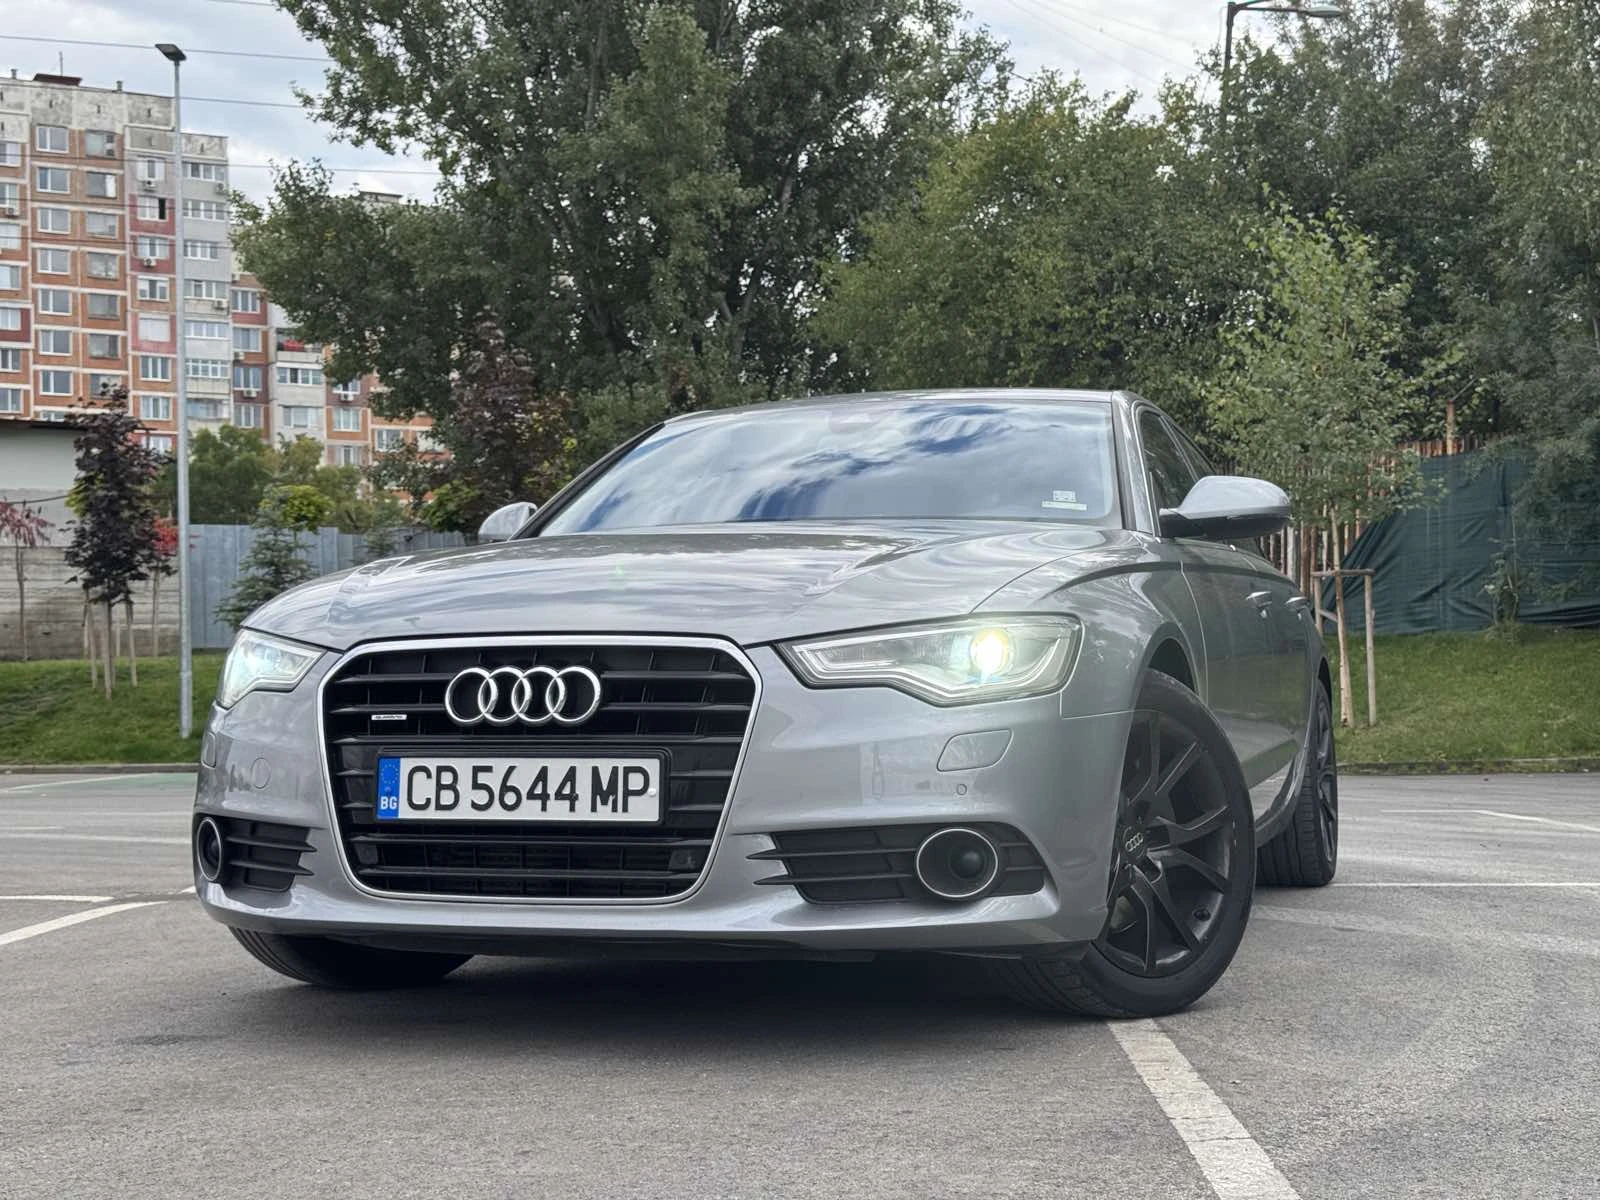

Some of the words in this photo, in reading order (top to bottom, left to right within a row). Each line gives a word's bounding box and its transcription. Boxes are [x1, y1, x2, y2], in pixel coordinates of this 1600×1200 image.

[380, 796, 398, 810] BG
[406, 765, 460, 811] CB
[470, 765, 579, 812] 5644
[590, 765, 650, 813] MP
